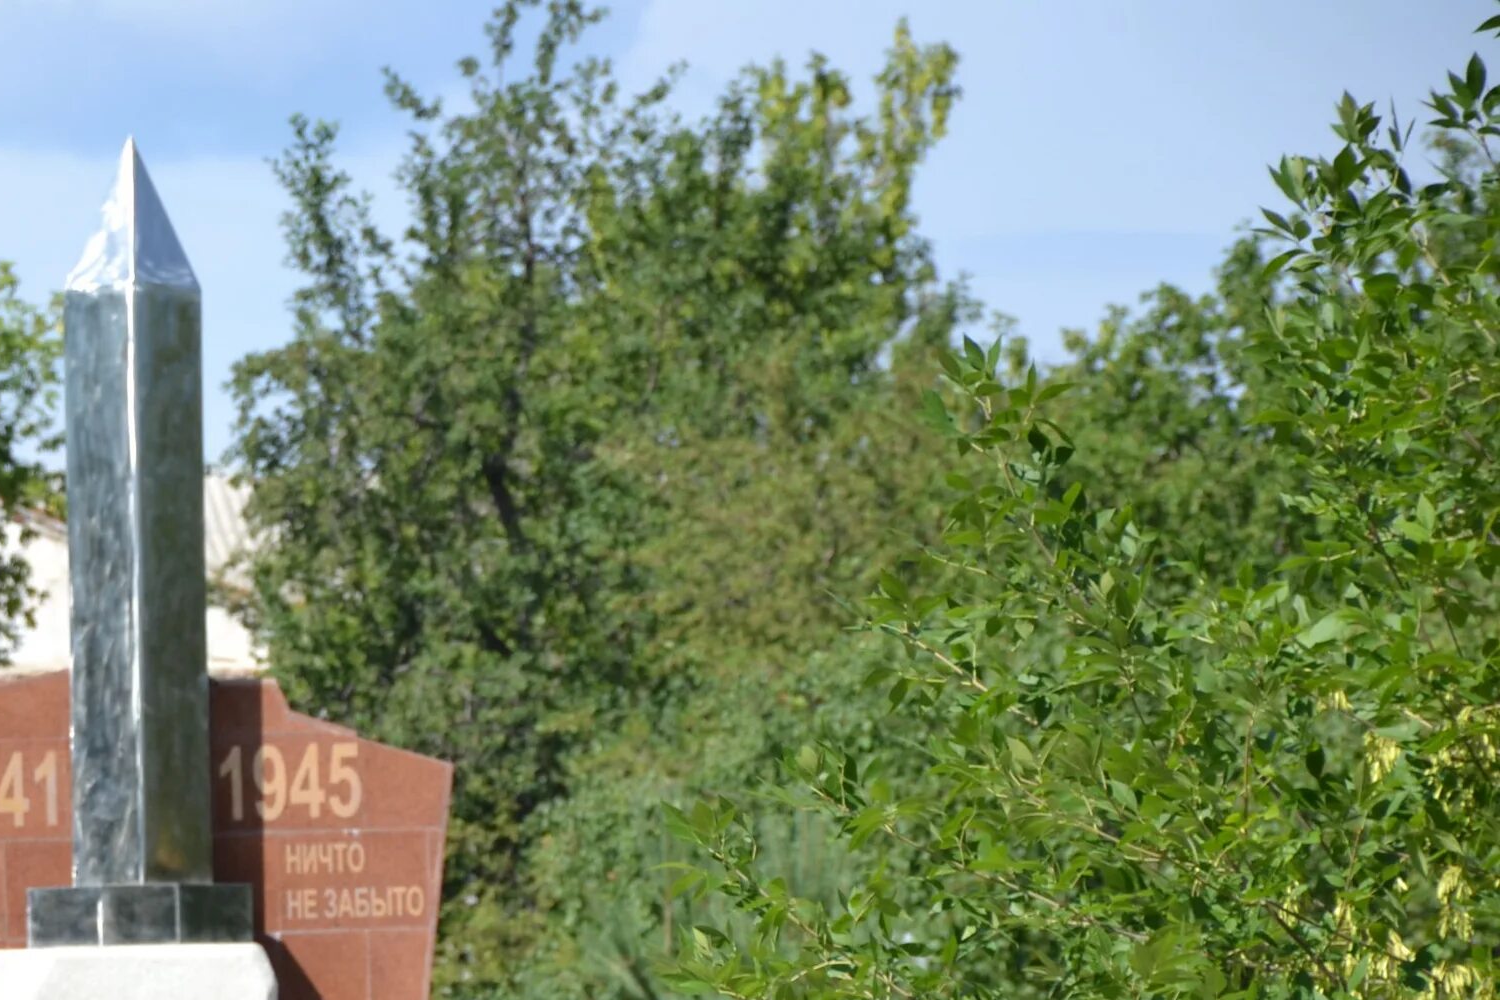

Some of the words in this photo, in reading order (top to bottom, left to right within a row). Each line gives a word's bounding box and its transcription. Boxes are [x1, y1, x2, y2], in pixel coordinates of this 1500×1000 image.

[219, 742, 362, 821] 1945
[286, 842, 365, 873] НИЧТО
[286, 888, 319, 919] НЕ
[325, 885, 424, 917] ЗАБЫТО
